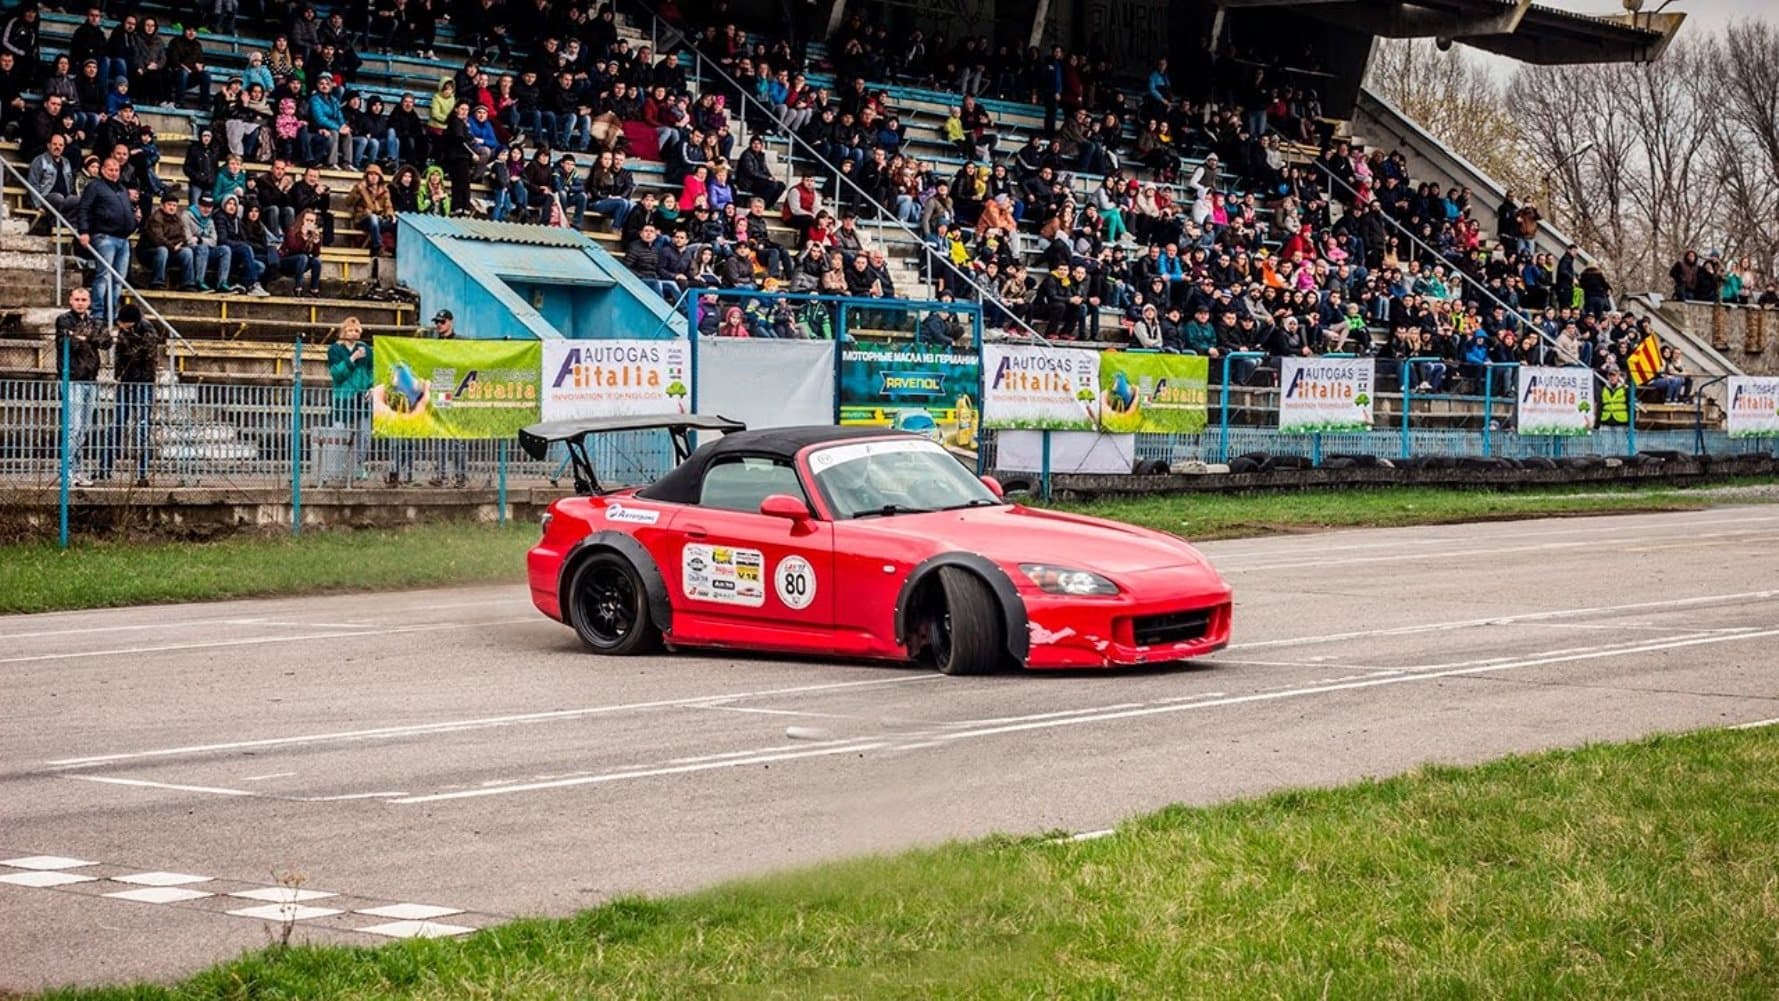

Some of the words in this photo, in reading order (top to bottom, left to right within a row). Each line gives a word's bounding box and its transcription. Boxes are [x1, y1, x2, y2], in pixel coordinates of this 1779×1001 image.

[584, 347, 660, 362] AUTOGAS
[1013, 356, 1073, 372] AUTOGAS
[1305, 367, 1354, 380] AUTOGAS
[886, 377, 940, 390] RAVENOL
[785, 573, 806, 596] 80
